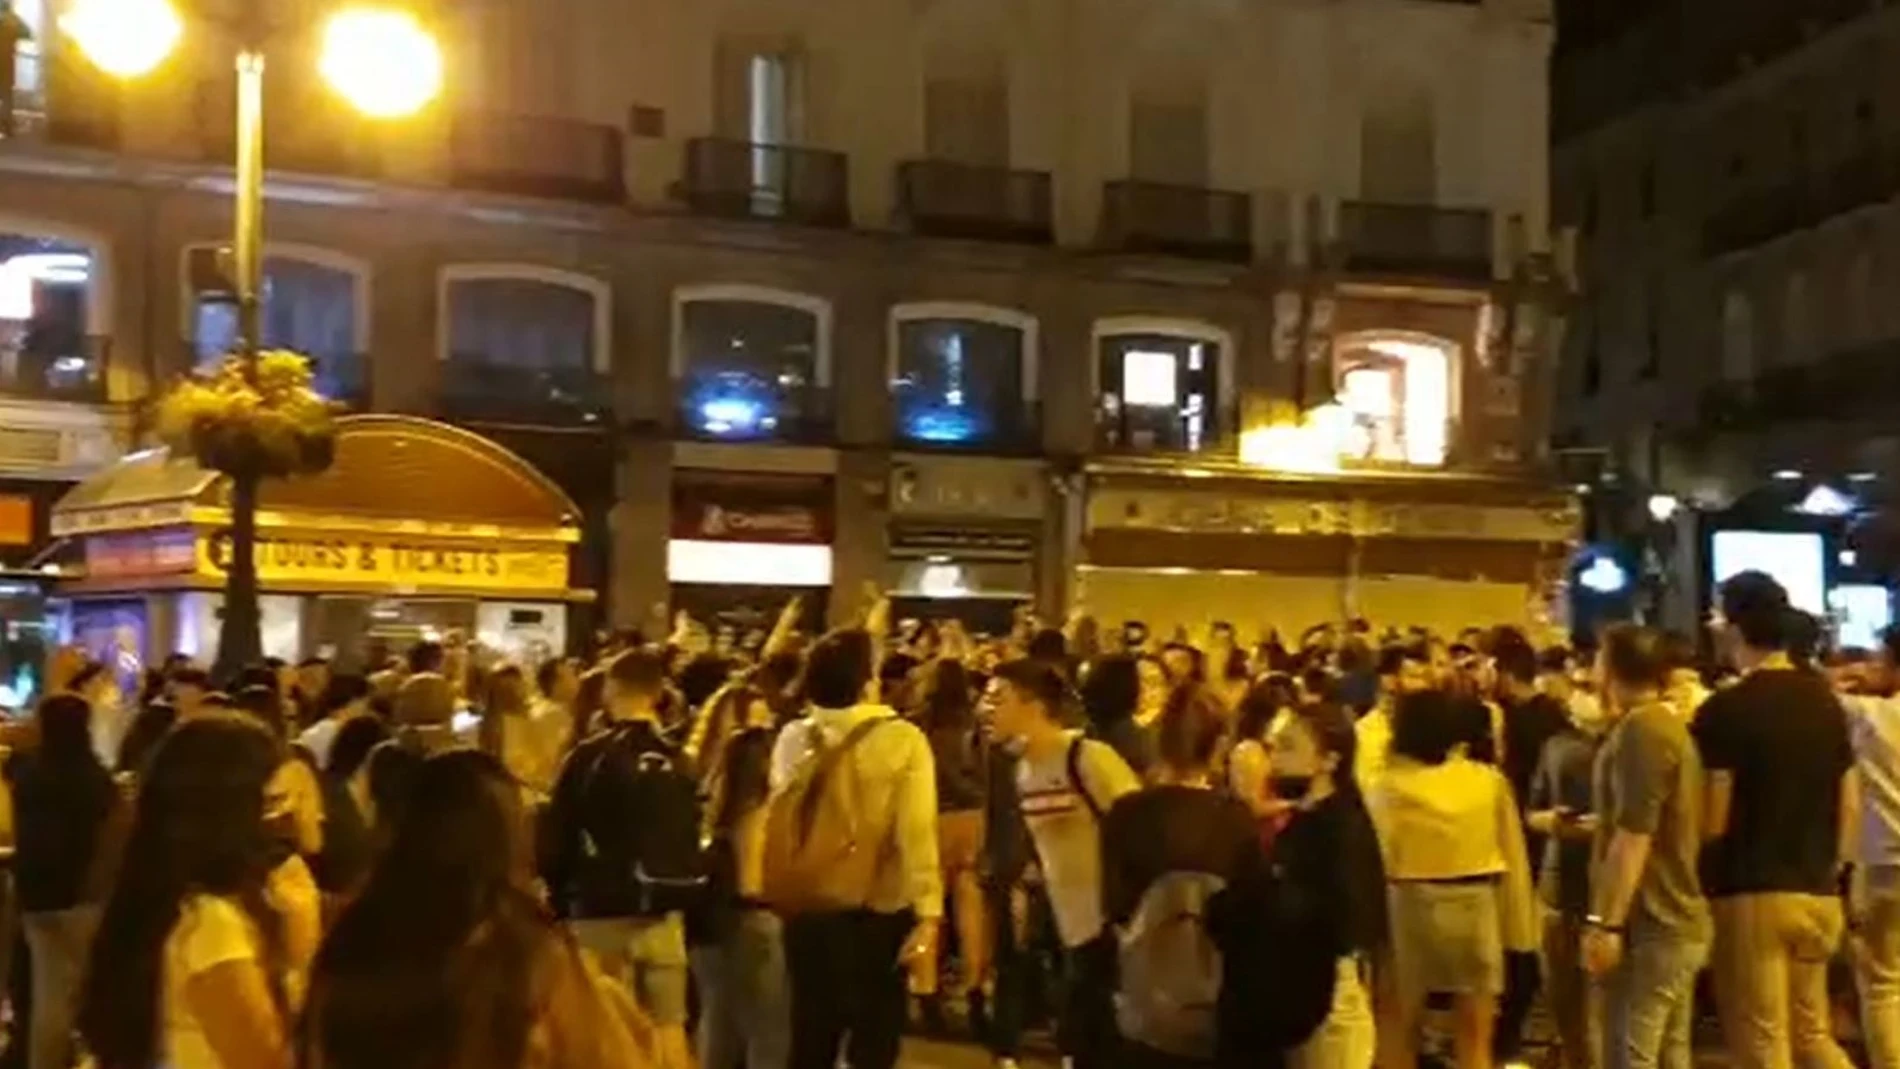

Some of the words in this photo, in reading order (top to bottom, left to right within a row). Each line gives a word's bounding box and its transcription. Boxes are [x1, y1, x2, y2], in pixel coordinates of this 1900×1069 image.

[255, 538, 347, 570] TOURS
[356, 541, 377, 571] &
[390, 543, 499, 577] TICKETS
